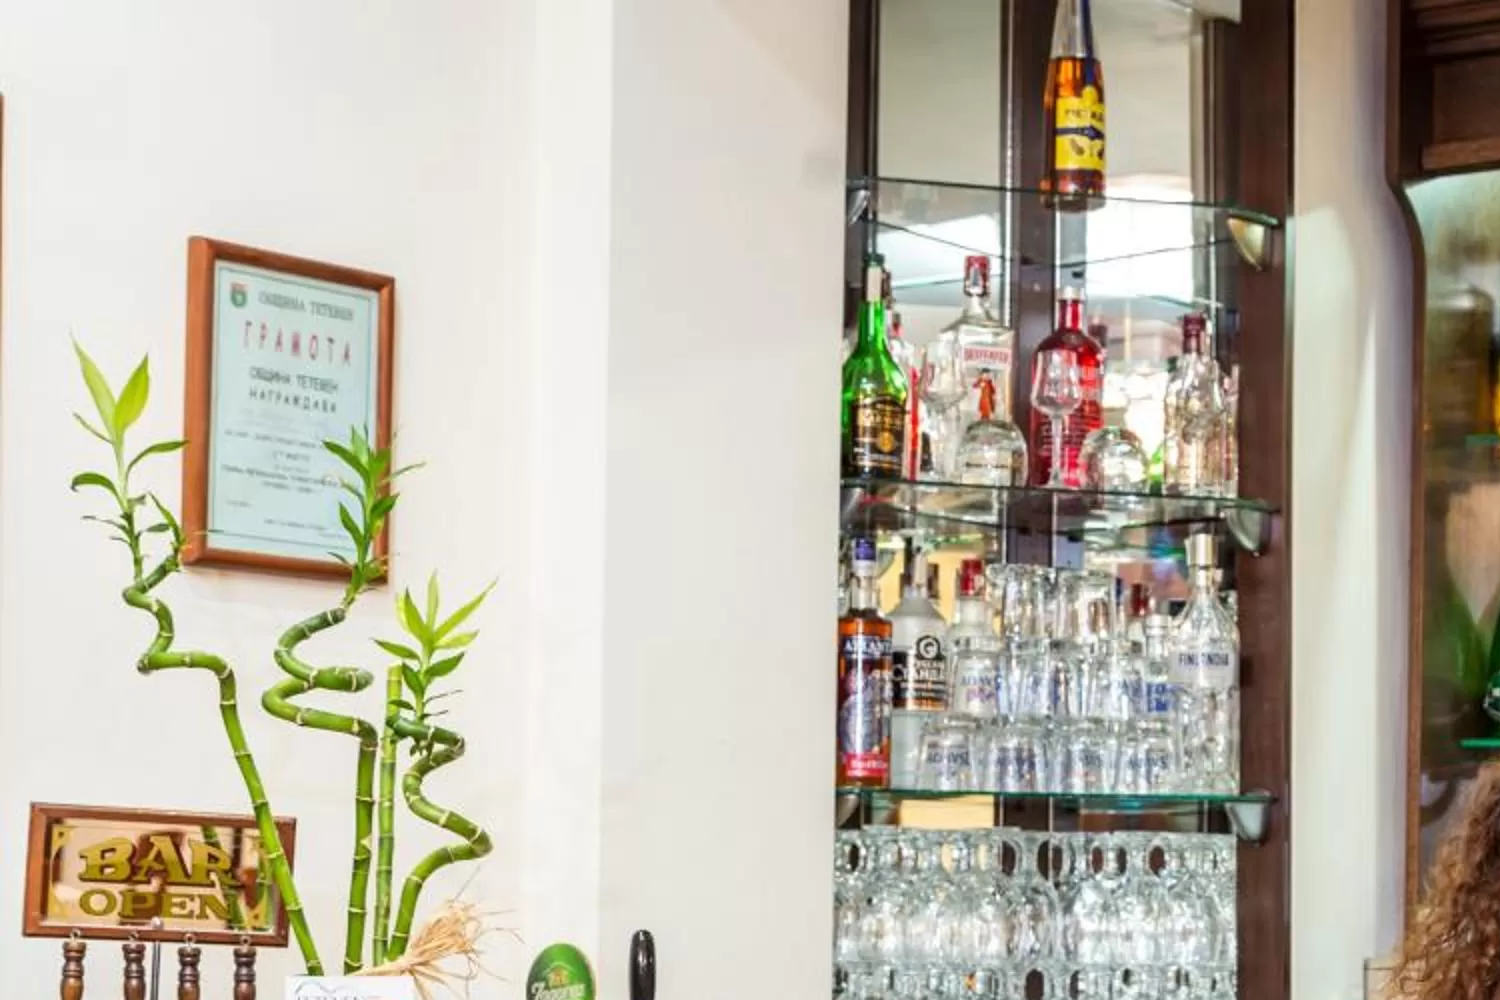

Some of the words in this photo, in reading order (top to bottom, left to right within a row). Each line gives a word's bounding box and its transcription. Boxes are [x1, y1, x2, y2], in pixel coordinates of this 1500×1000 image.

[243, 318, 353, 367] ГРАМОТА
[78, 832, 243, 890] BAR
[79, 888, 235, 922] OPEN
